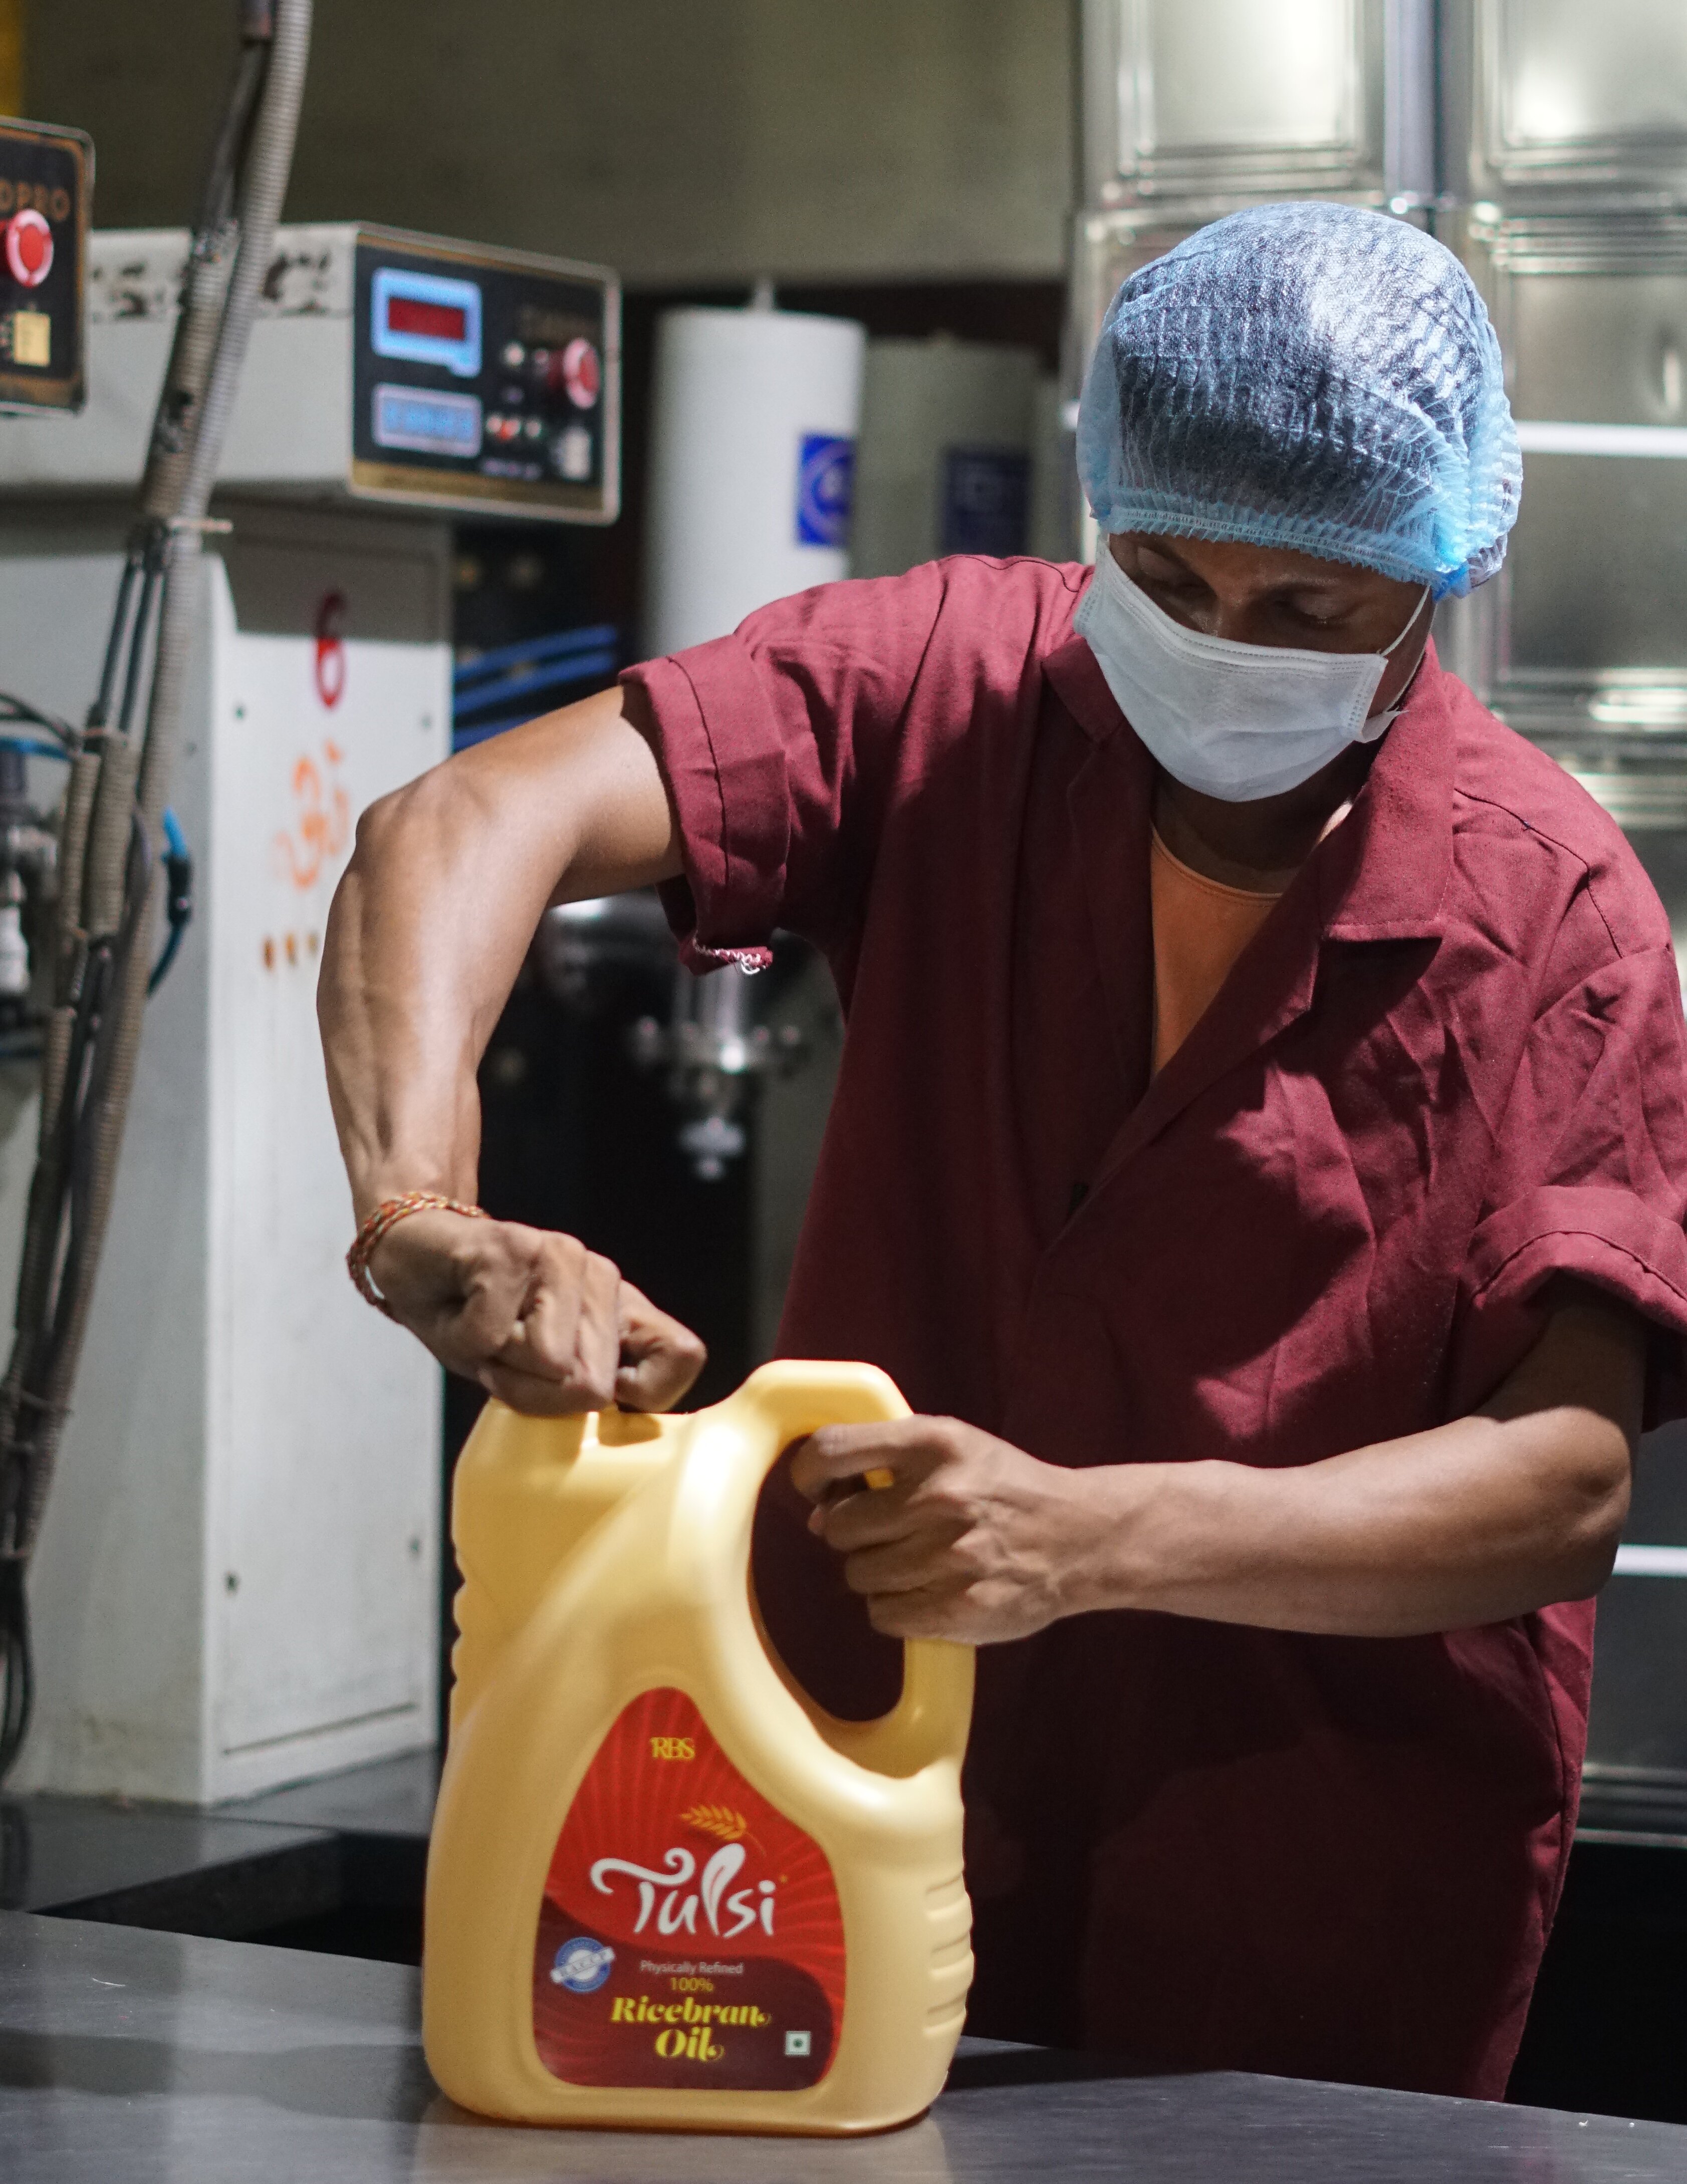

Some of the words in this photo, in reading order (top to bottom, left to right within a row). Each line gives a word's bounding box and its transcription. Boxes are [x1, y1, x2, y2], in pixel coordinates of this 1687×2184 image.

[650, 1737, 695, 1760] RBS
[590, 1843, 776, 1938] Tulsi
[640, 1960, 695, 1975] Physically
[699, 1961, 744, 1975] Refined
[670, 1977, 714, 1992] 100%
[610, 1995, 772, 2027] Ricebran
[654, 2027, 725, 2062] Oil
